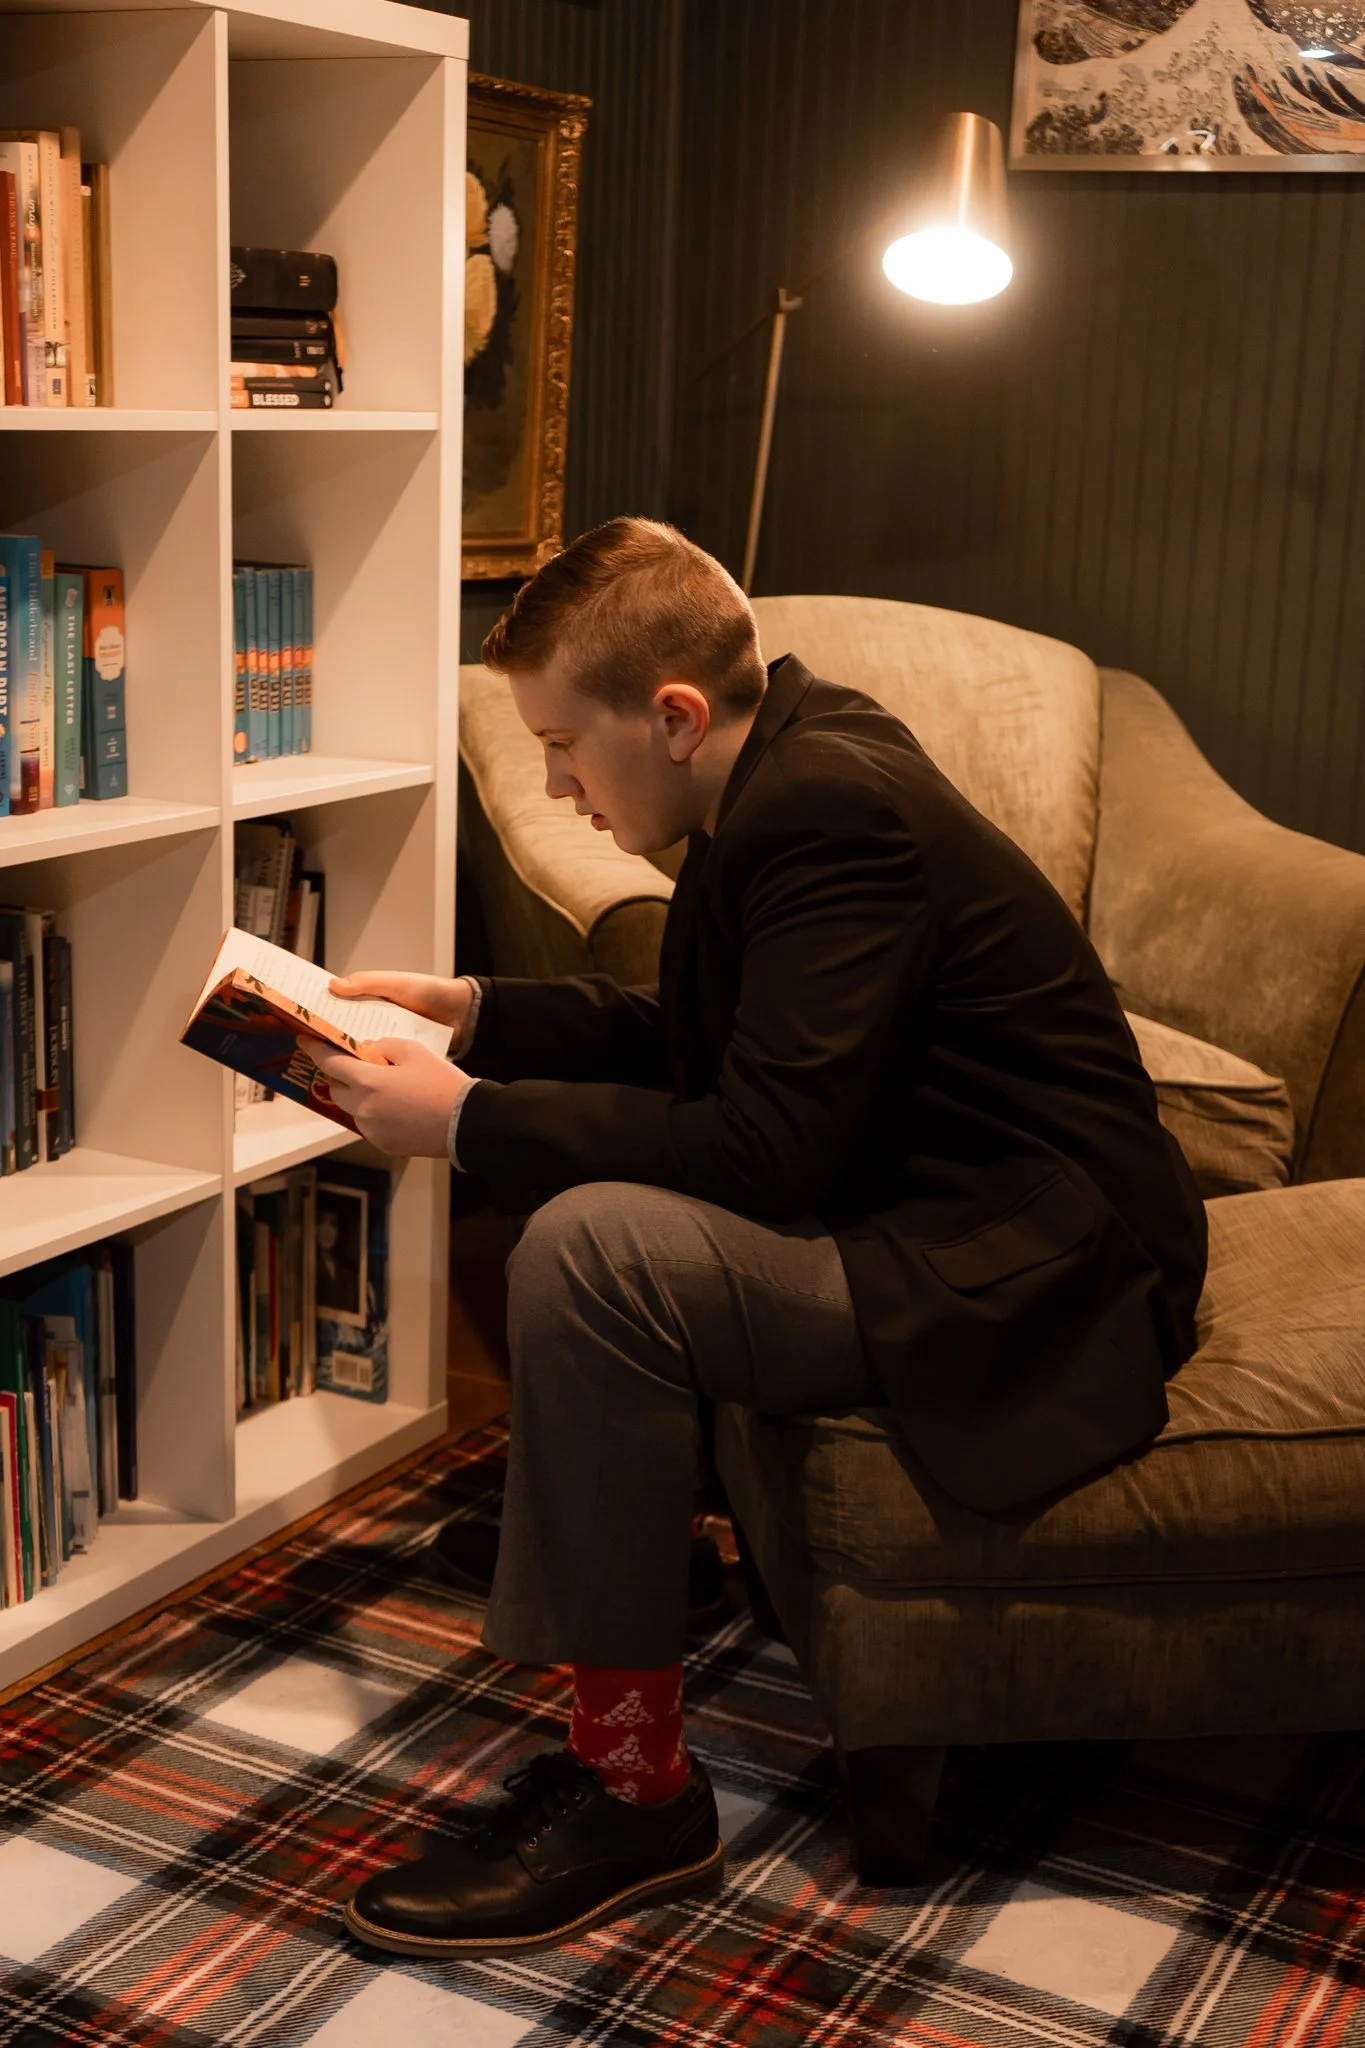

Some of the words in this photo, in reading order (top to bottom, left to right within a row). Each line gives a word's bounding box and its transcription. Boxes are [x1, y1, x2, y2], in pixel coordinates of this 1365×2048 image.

[252, 393, 300, 406] BLESSED
[28, 582, 39, 662] Hilderbrand
[67, 615, 76, 641] THE
[66, 644, 76, 676] LAST
[65, 679, 75, 725] LETTER
